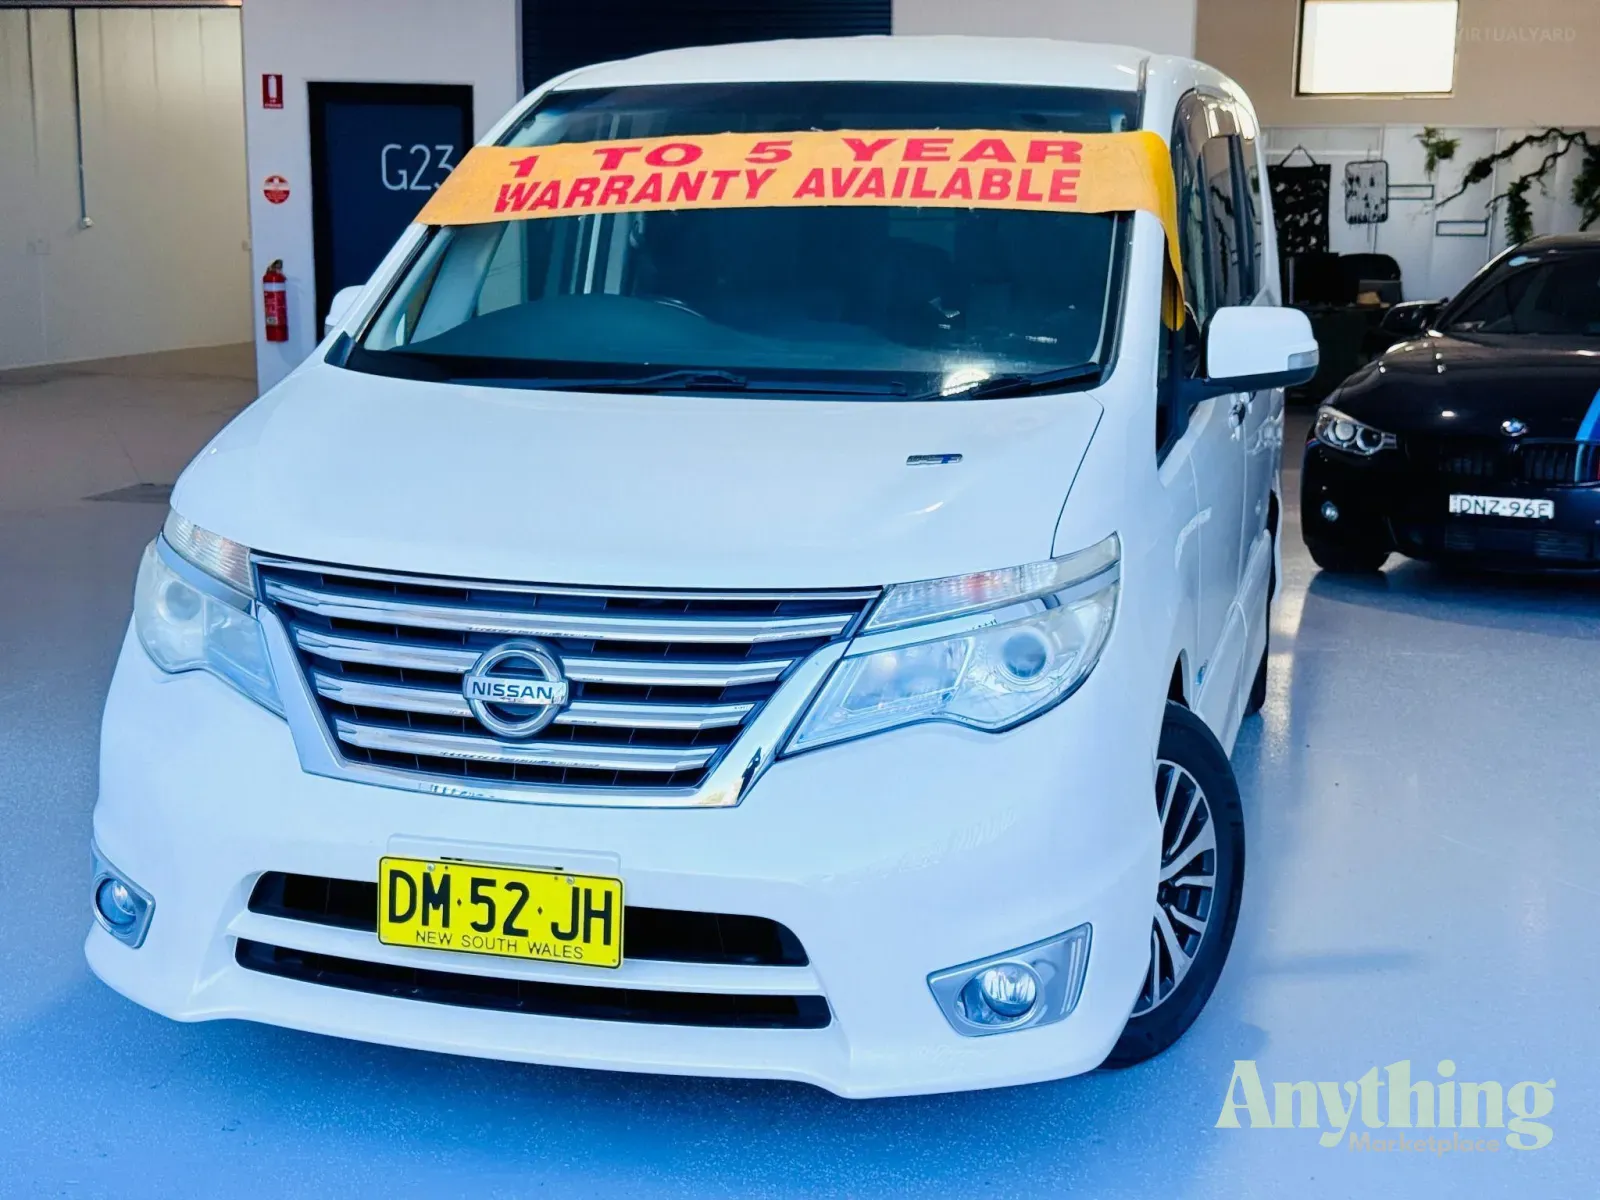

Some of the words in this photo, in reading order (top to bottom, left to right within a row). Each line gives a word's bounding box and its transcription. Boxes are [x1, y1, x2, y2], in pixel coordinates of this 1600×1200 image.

[381, 143, 454, 191] G23
[509, 155, 540, 179] 1
[592, 143, 704, 171] TO
[744, 139, 793, 164] 5
[841, 137, 1084, 163] YEAR
[494, 168, 777, 213] WARRANTY
[792, 167, 1081, 203] AVAILABLE
[472, 681, 553, 700] NISSAN
[416, 930, 453, 945] NEW
[461, 934, 518, 954] SOUTH
[527, 941, 584, 959] WALES
